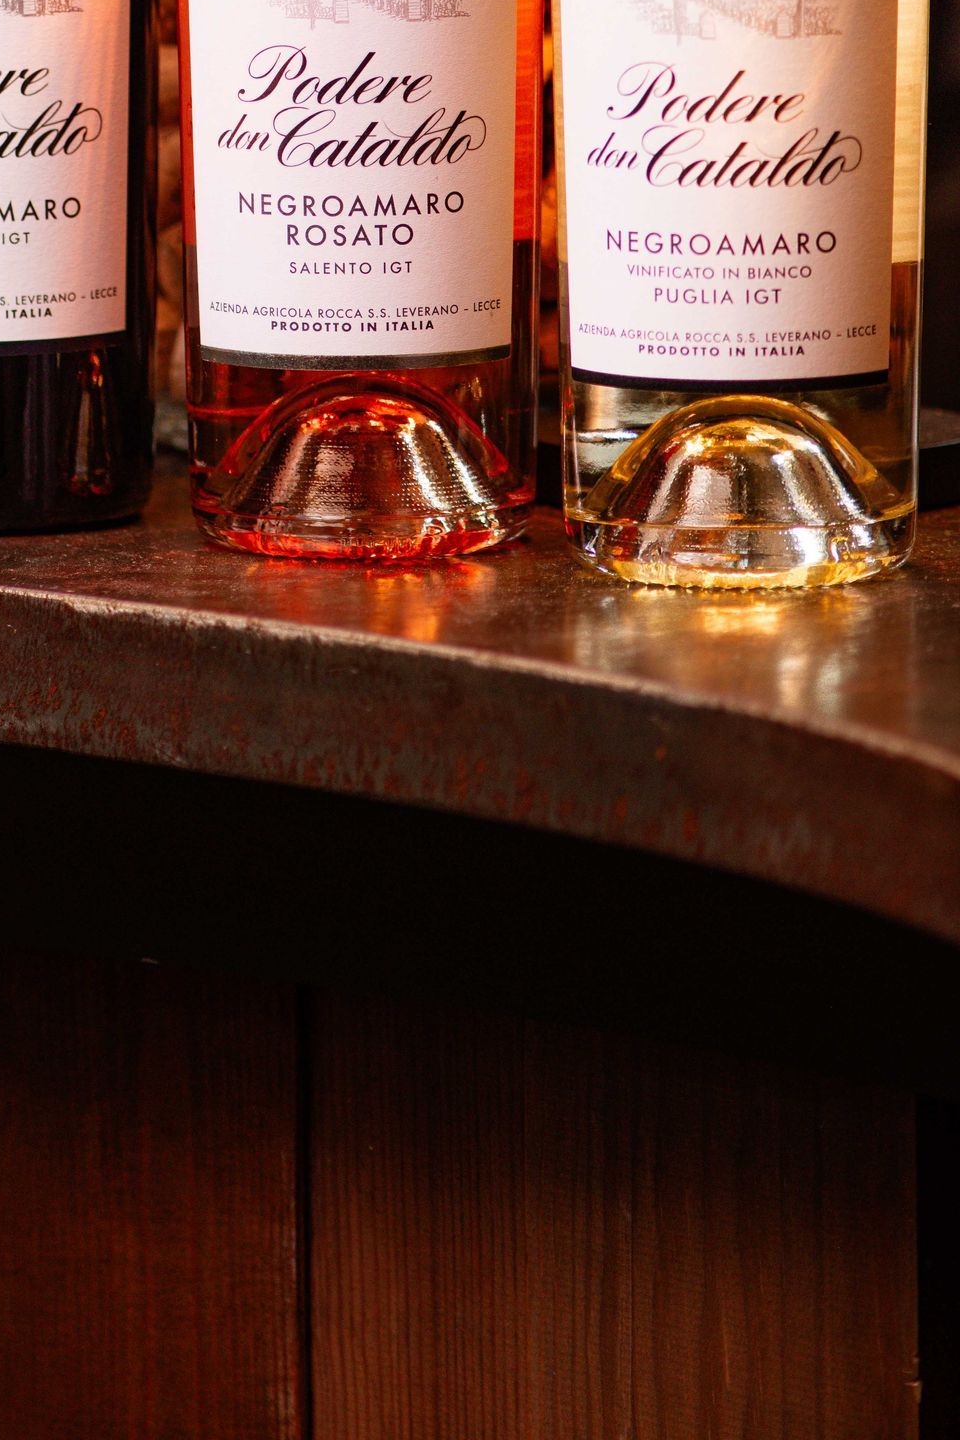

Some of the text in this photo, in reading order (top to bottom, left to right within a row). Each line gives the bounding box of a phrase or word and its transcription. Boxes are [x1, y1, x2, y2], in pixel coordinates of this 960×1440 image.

[238, 44, 432, 105] Podere
[607, 61, 804, 124] Podere
[218, 107, 487, 169] don Cataldo
[587, 124, 863, 188] don Cataldo
[238, 191, 464, 217] NEGROAMARO
[2, 232, 31, 246] IGT
[286, 223, 414, 247] ROSATO
[606, 229, 837, 256] NEGROAMARO
[289, 260, 413, 275] SALENTO IGT
[627, 264, 812, 280] VINIFICATO IN BIANCO
[15, 292, 77, 306] LEVERANO
[90, 286, 118, 301] LECCE
[653, 287, 783, 305] PUGLIA IGT
[5, 307, 53, 319] ITALIA
[209, 300, 248, 316] AZIENDA
[252, 305, 313, 319] AGRICOLA
[318, 307, 363, 319] ROCCA
[368, 307, 391, 319] S.S.
[396, 304, 459, 318] LEVERANO
[473, 298, 501, 313] LECCE
[271, 320, 434, 333] PRODOTTO IN ITALIA
[578, 323, 617, 338] AZIENDA
[620, 328, 680, 342] AGRICOLA
[685, 332, 730, 343] ROCCA
[736, 332, 760, 343] S.S.
[765, 329, 832, 343] LEVERANO
[846, 324, 877, 339] LECCE
[638, 344, 805, 357] PRODOTTO IN ITALIA
